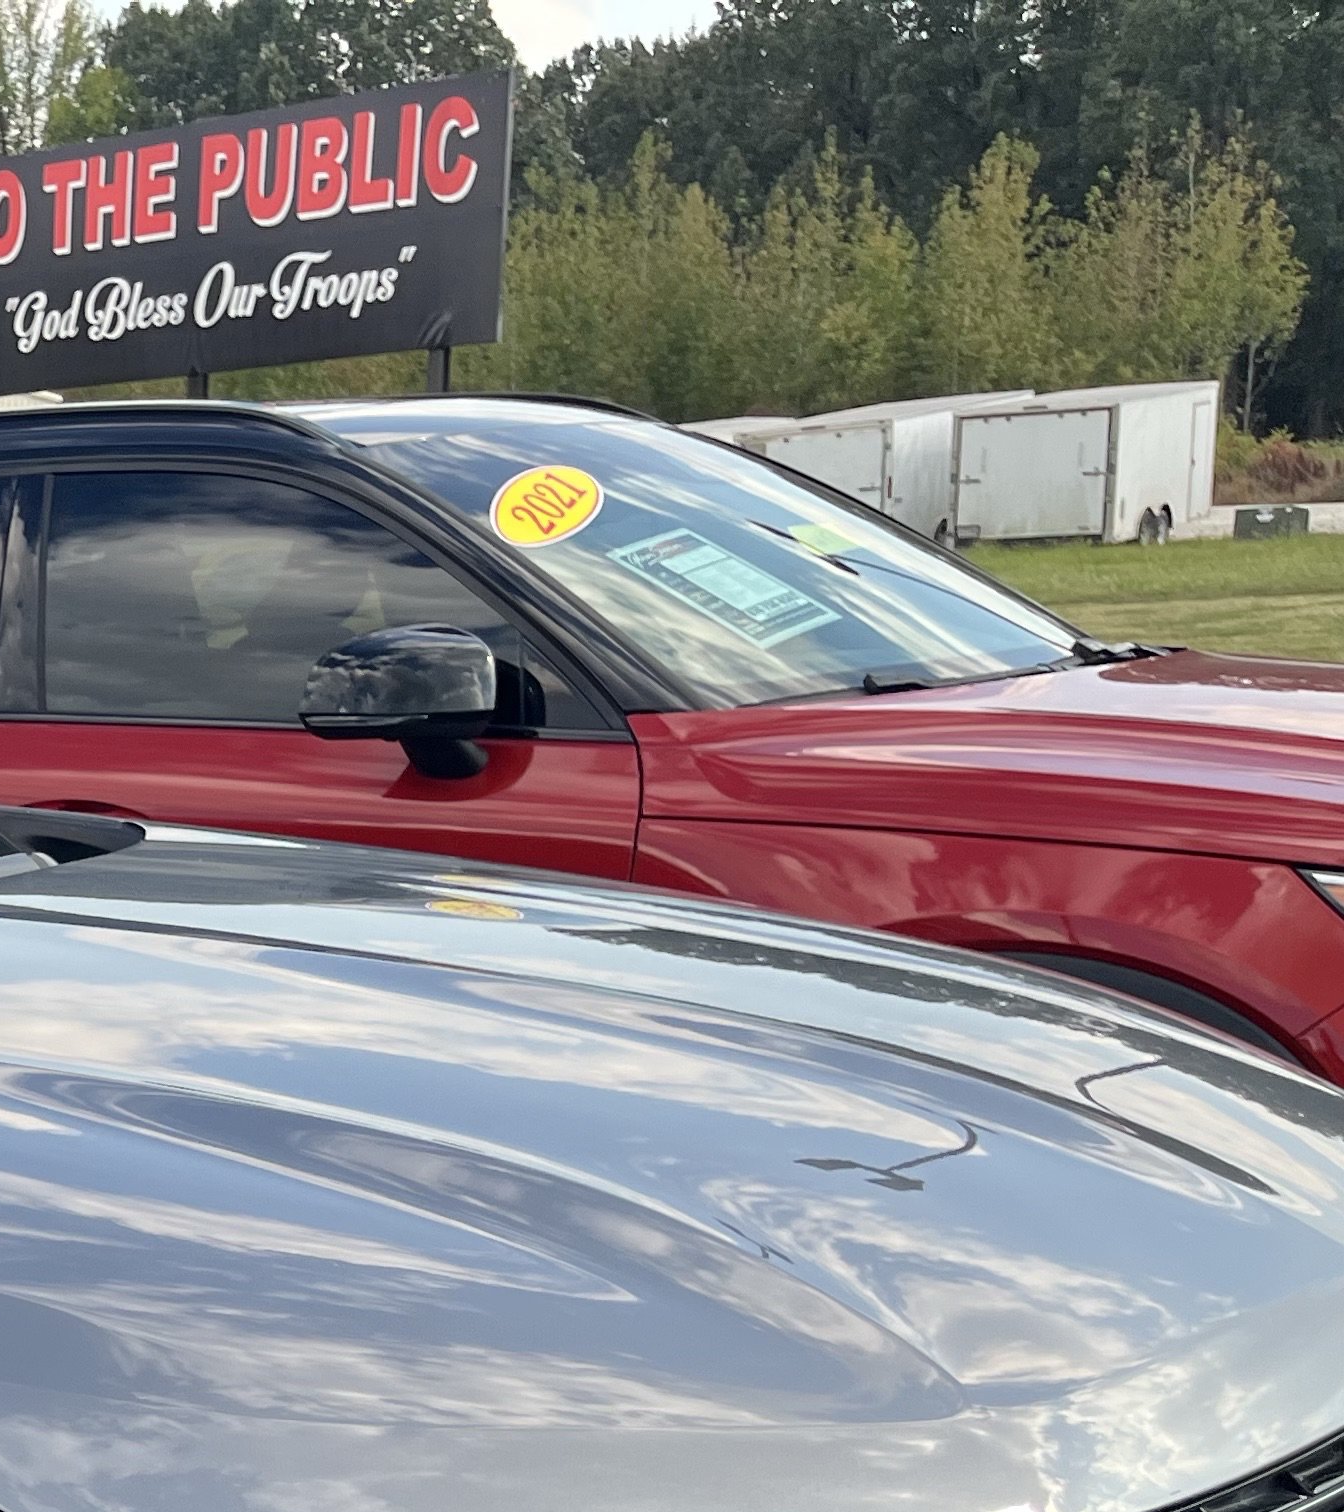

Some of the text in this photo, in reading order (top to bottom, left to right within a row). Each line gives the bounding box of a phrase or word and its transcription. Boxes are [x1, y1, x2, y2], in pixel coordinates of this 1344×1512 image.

[42, 140, 179, 257] THE
[197, 95, 480, 234] PUBLIC
[4, 244, 418, 354] "God Bless Our Troops"
[511, 472, 587, 535] 2021
